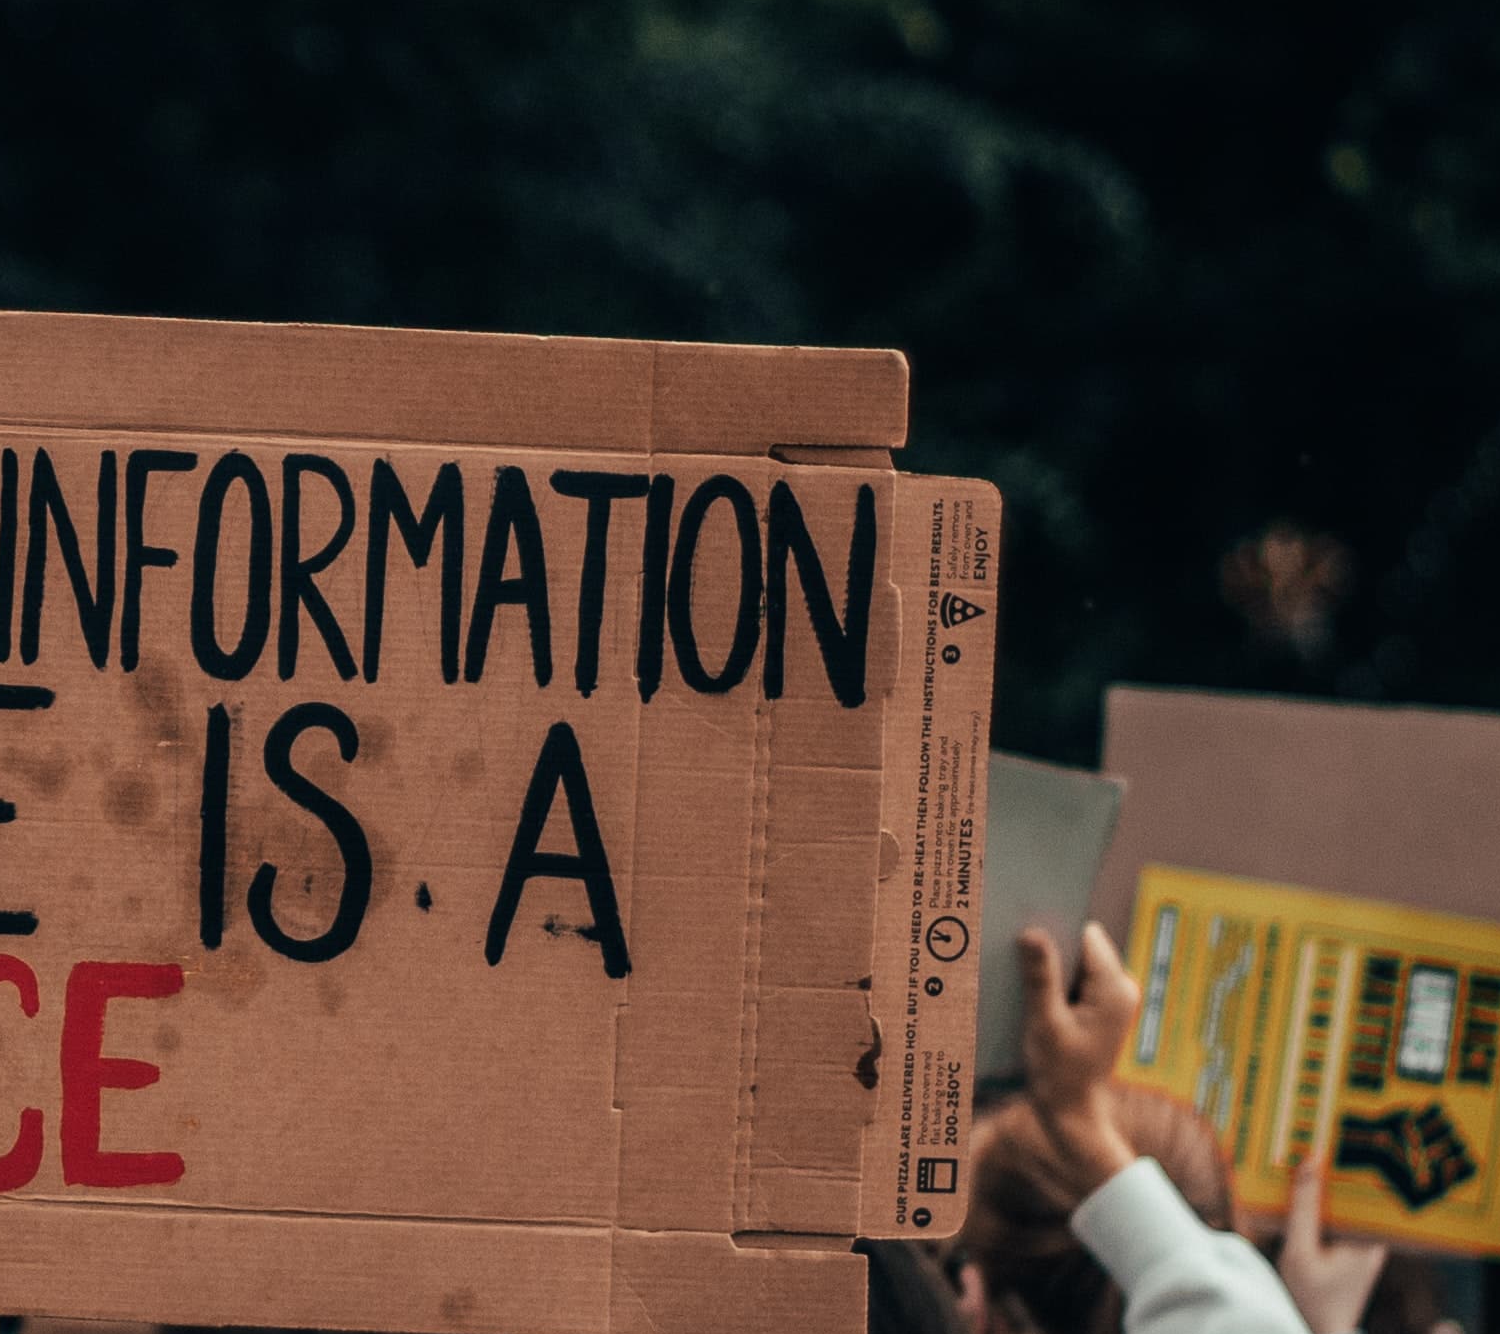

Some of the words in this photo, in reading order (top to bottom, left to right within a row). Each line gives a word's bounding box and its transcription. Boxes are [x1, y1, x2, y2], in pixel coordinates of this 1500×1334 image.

[949, 500, 960, 544] remove
[963, 500, 973, 520] and
[931, 498, 944, 555] RESULTS.
[961, 522, 971, 549] oven
[947, 546, 960, 580] Safely
[959, 552, 970, 580] from
[973, 528, 990, 580] ENJOY
[929, 558, 940, 587] BEST
[928, 591, 939, 616] FOR
[923, 620, 937, 711] INSTRUCTIONS
[921, 715, 932, 737] THE
[938, 736, 948, 757] and
[919, 741, 931, 793] FOLLOW
[938, 760, 949, 780] tray
[948, 740, 962, 818] approximately
[917, 797, 927, 830] THEN
[936, 784, 948, 819] baking
[200, 702, 372, 963] IS
[484, 721, 633, 980] A
[935, 822, 944, 847] onto
[946, 821, 956, 836] for
[913, 833, 925, 886] RE-HEAT
[933, 850, 944, 876] pizza
[946, 839, 955, 866] oven
[957, 818, 973, 894] MINUTES
[944, 868, 954, 877] in
[913, 890, 923, 907] TO
[929, 880, 942, 908] Place
[943, 880, 954, 909] leave
[957, 900, 968, 908] 2
[911, 910, 921, 944] NEED
[909, 948, 920, 974] YOU
[909, 977, 918, 988] IF
[907, 993, 917, 1014] BUT
[905, 1018, 918, 1049] HOT,
[921, 1051, 931, 1071] and
[935, 1051, 944, 1061] to
[902, 1054, 914, 1121] DELIVERED
[922, 1073, 930, 1099] oven
[934, 1066, 945, 1087] tray
[932, 1090, 944, 1126] baking
[900, 1125, 910, 1148] ARE
[916, 1104, 929, 1146] Preheat
[931, 1129, 940, 1146] flat
[898, 1152, 909, 1193] PIZZAS
[896, 1197, 907, 1225] OUR
